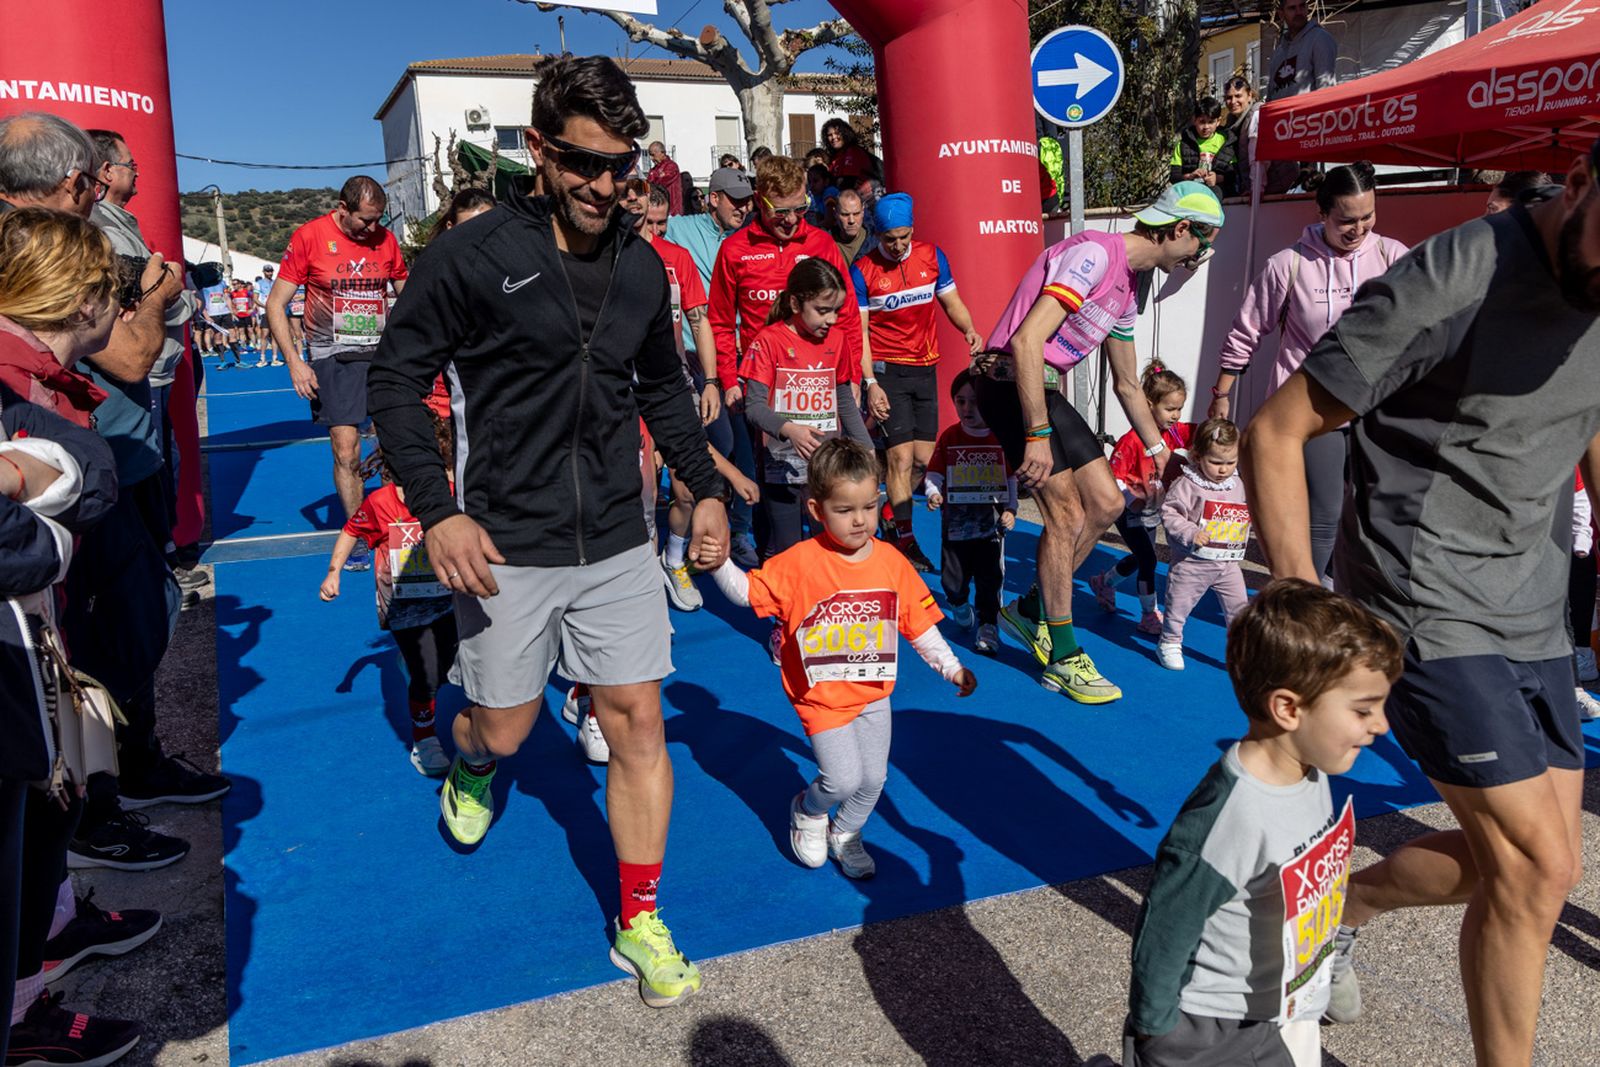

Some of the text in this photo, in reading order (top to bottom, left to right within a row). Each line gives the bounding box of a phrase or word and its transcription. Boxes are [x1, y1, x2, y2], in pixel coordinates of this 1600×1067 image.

[0, 80, 154, 114] NTAMIENTO
[1505, 95, 1587, 117] TIENDA RUNNING
[1274, 94, 1418, 146] alssport.es
[1325, 134, 1353, 145] RUNNING
[1358, 131, 1376, 140] TRAIL
[1381, 124, 1416, 138] OUTDOOR
[1001, 179, 1022, 193] DE
[979, 219, 1039, 235] MARTOS
[900, 292, 933, 305] Avanza
[342, 314, 378, 331] 394
[786, 373, 830, 386] X CROSS
[783, 391, 833, 412] 1065
[956, 450, 998, 461] X CROSS
[1213, 504, 1223, 516] X
[401, 527, 416, 542] X
[829, 600, 881, 615] CROSS
[804, 621, 885, 654] 5061
[1294, 859, 1314, 898] X
[1314, 828, 1350, 883] CROSS
